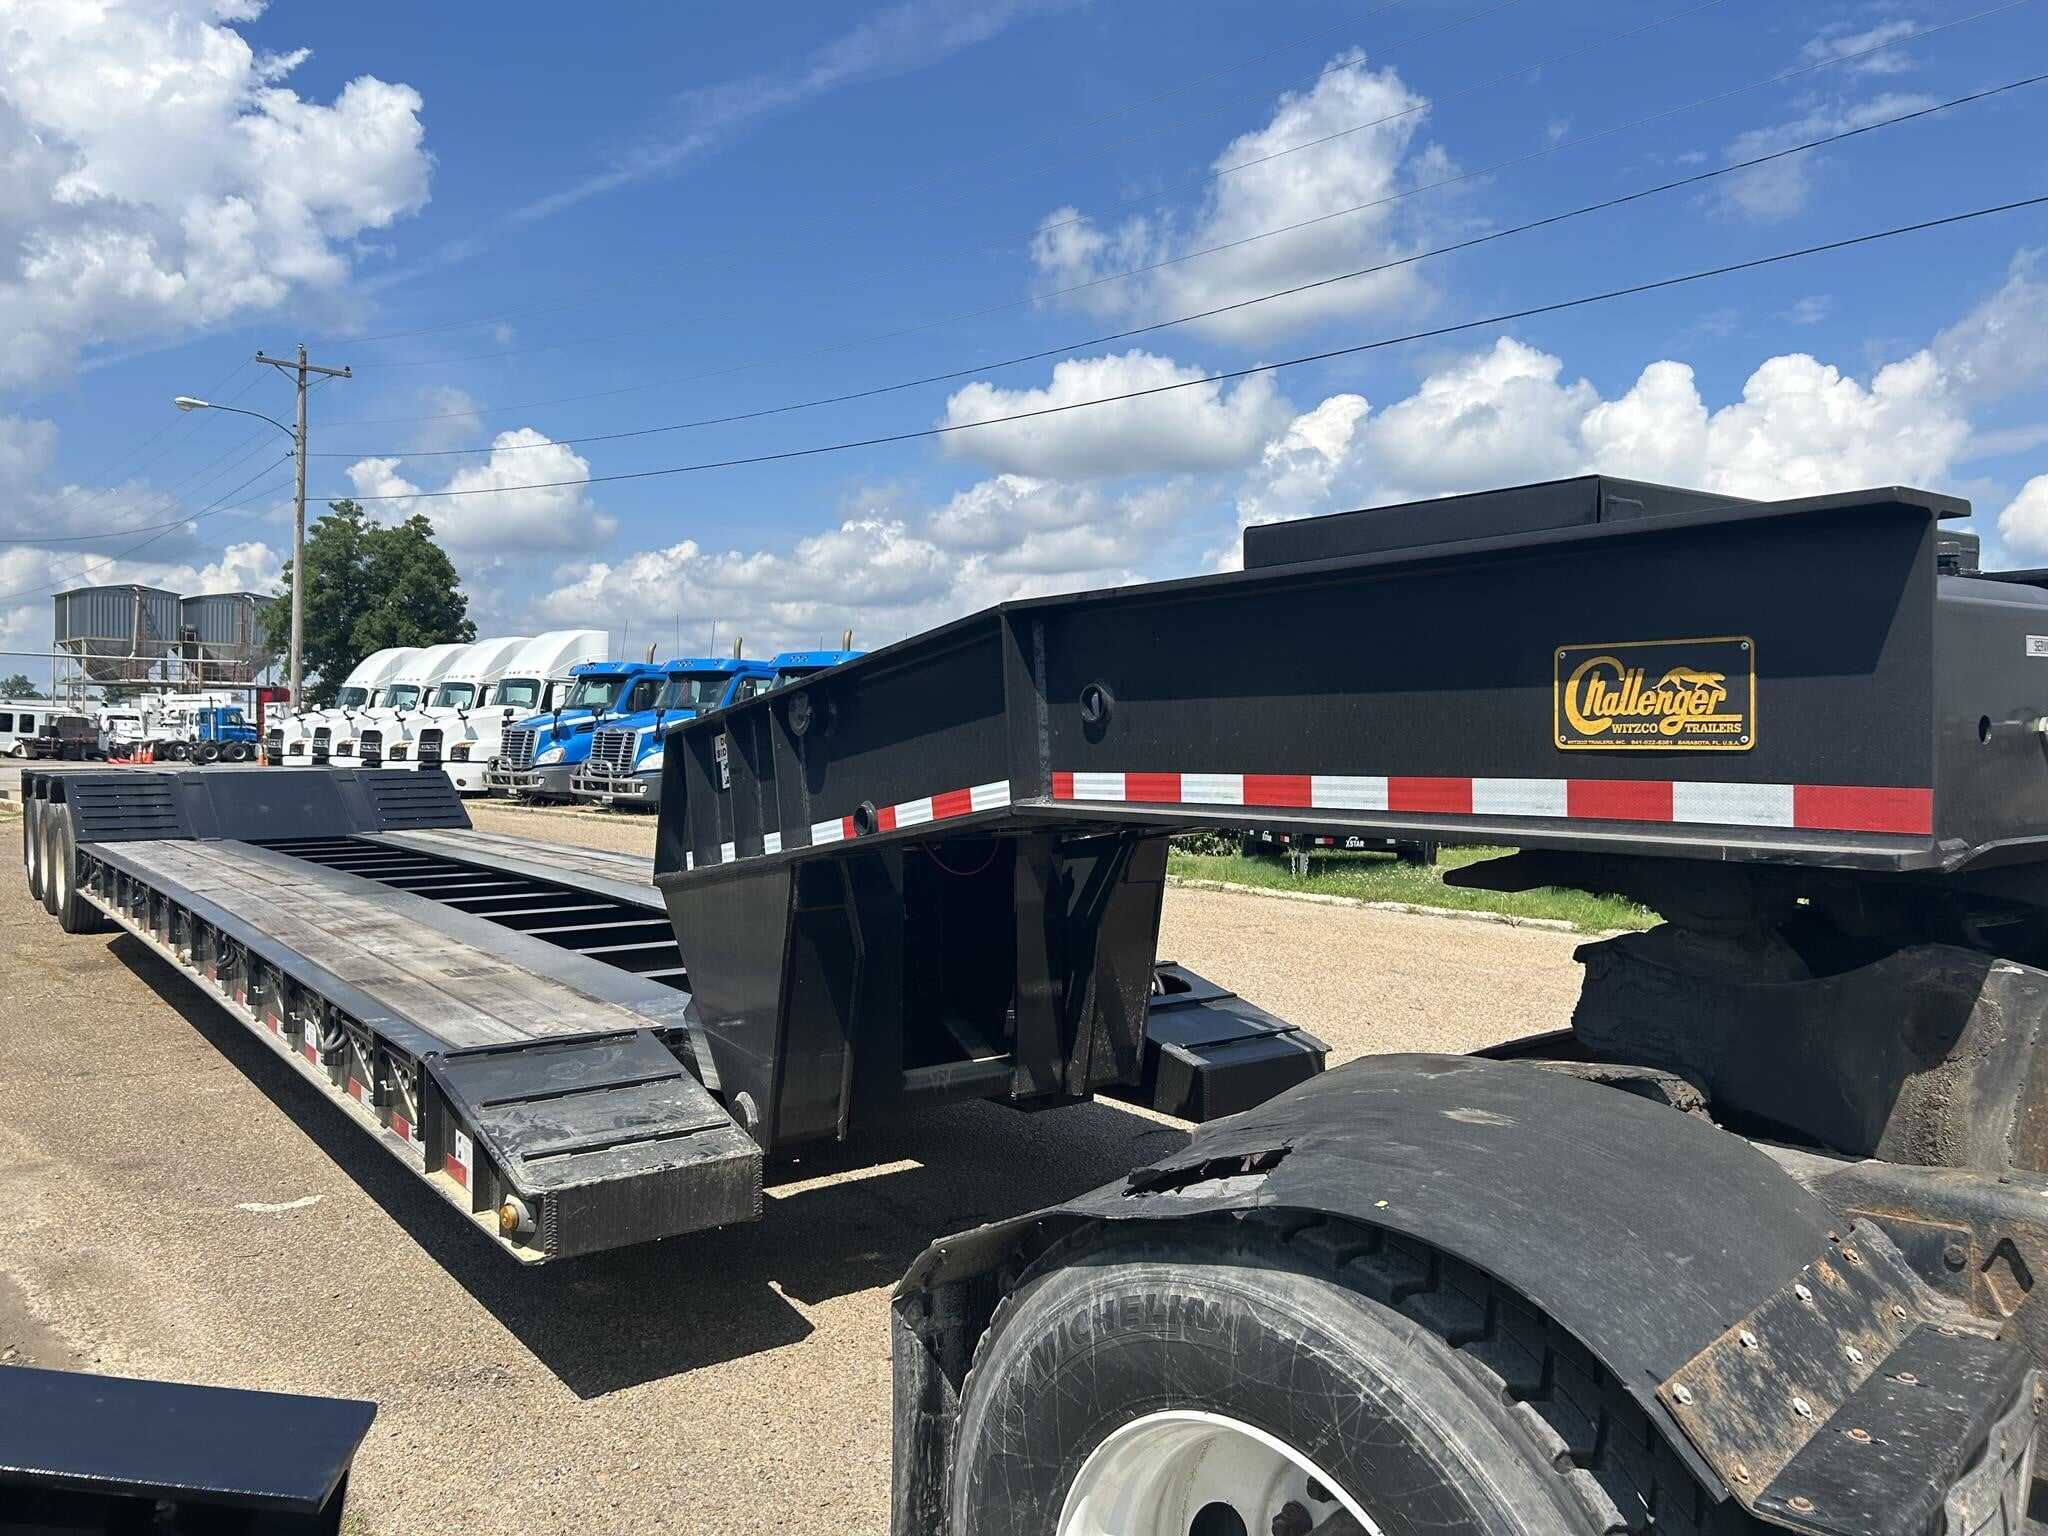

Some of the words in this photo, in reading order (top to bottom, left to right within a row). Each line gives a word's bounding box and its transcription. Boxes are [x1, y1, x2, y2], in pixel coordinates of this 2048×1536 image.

[1564, 656, 1728, 735] Challenger
[1612, 723, 1658, 734] WITZCO
[1685, 723, 1742, 733] TRAILERS
[1026, 1293, 1223, 1384] MICHELIN
